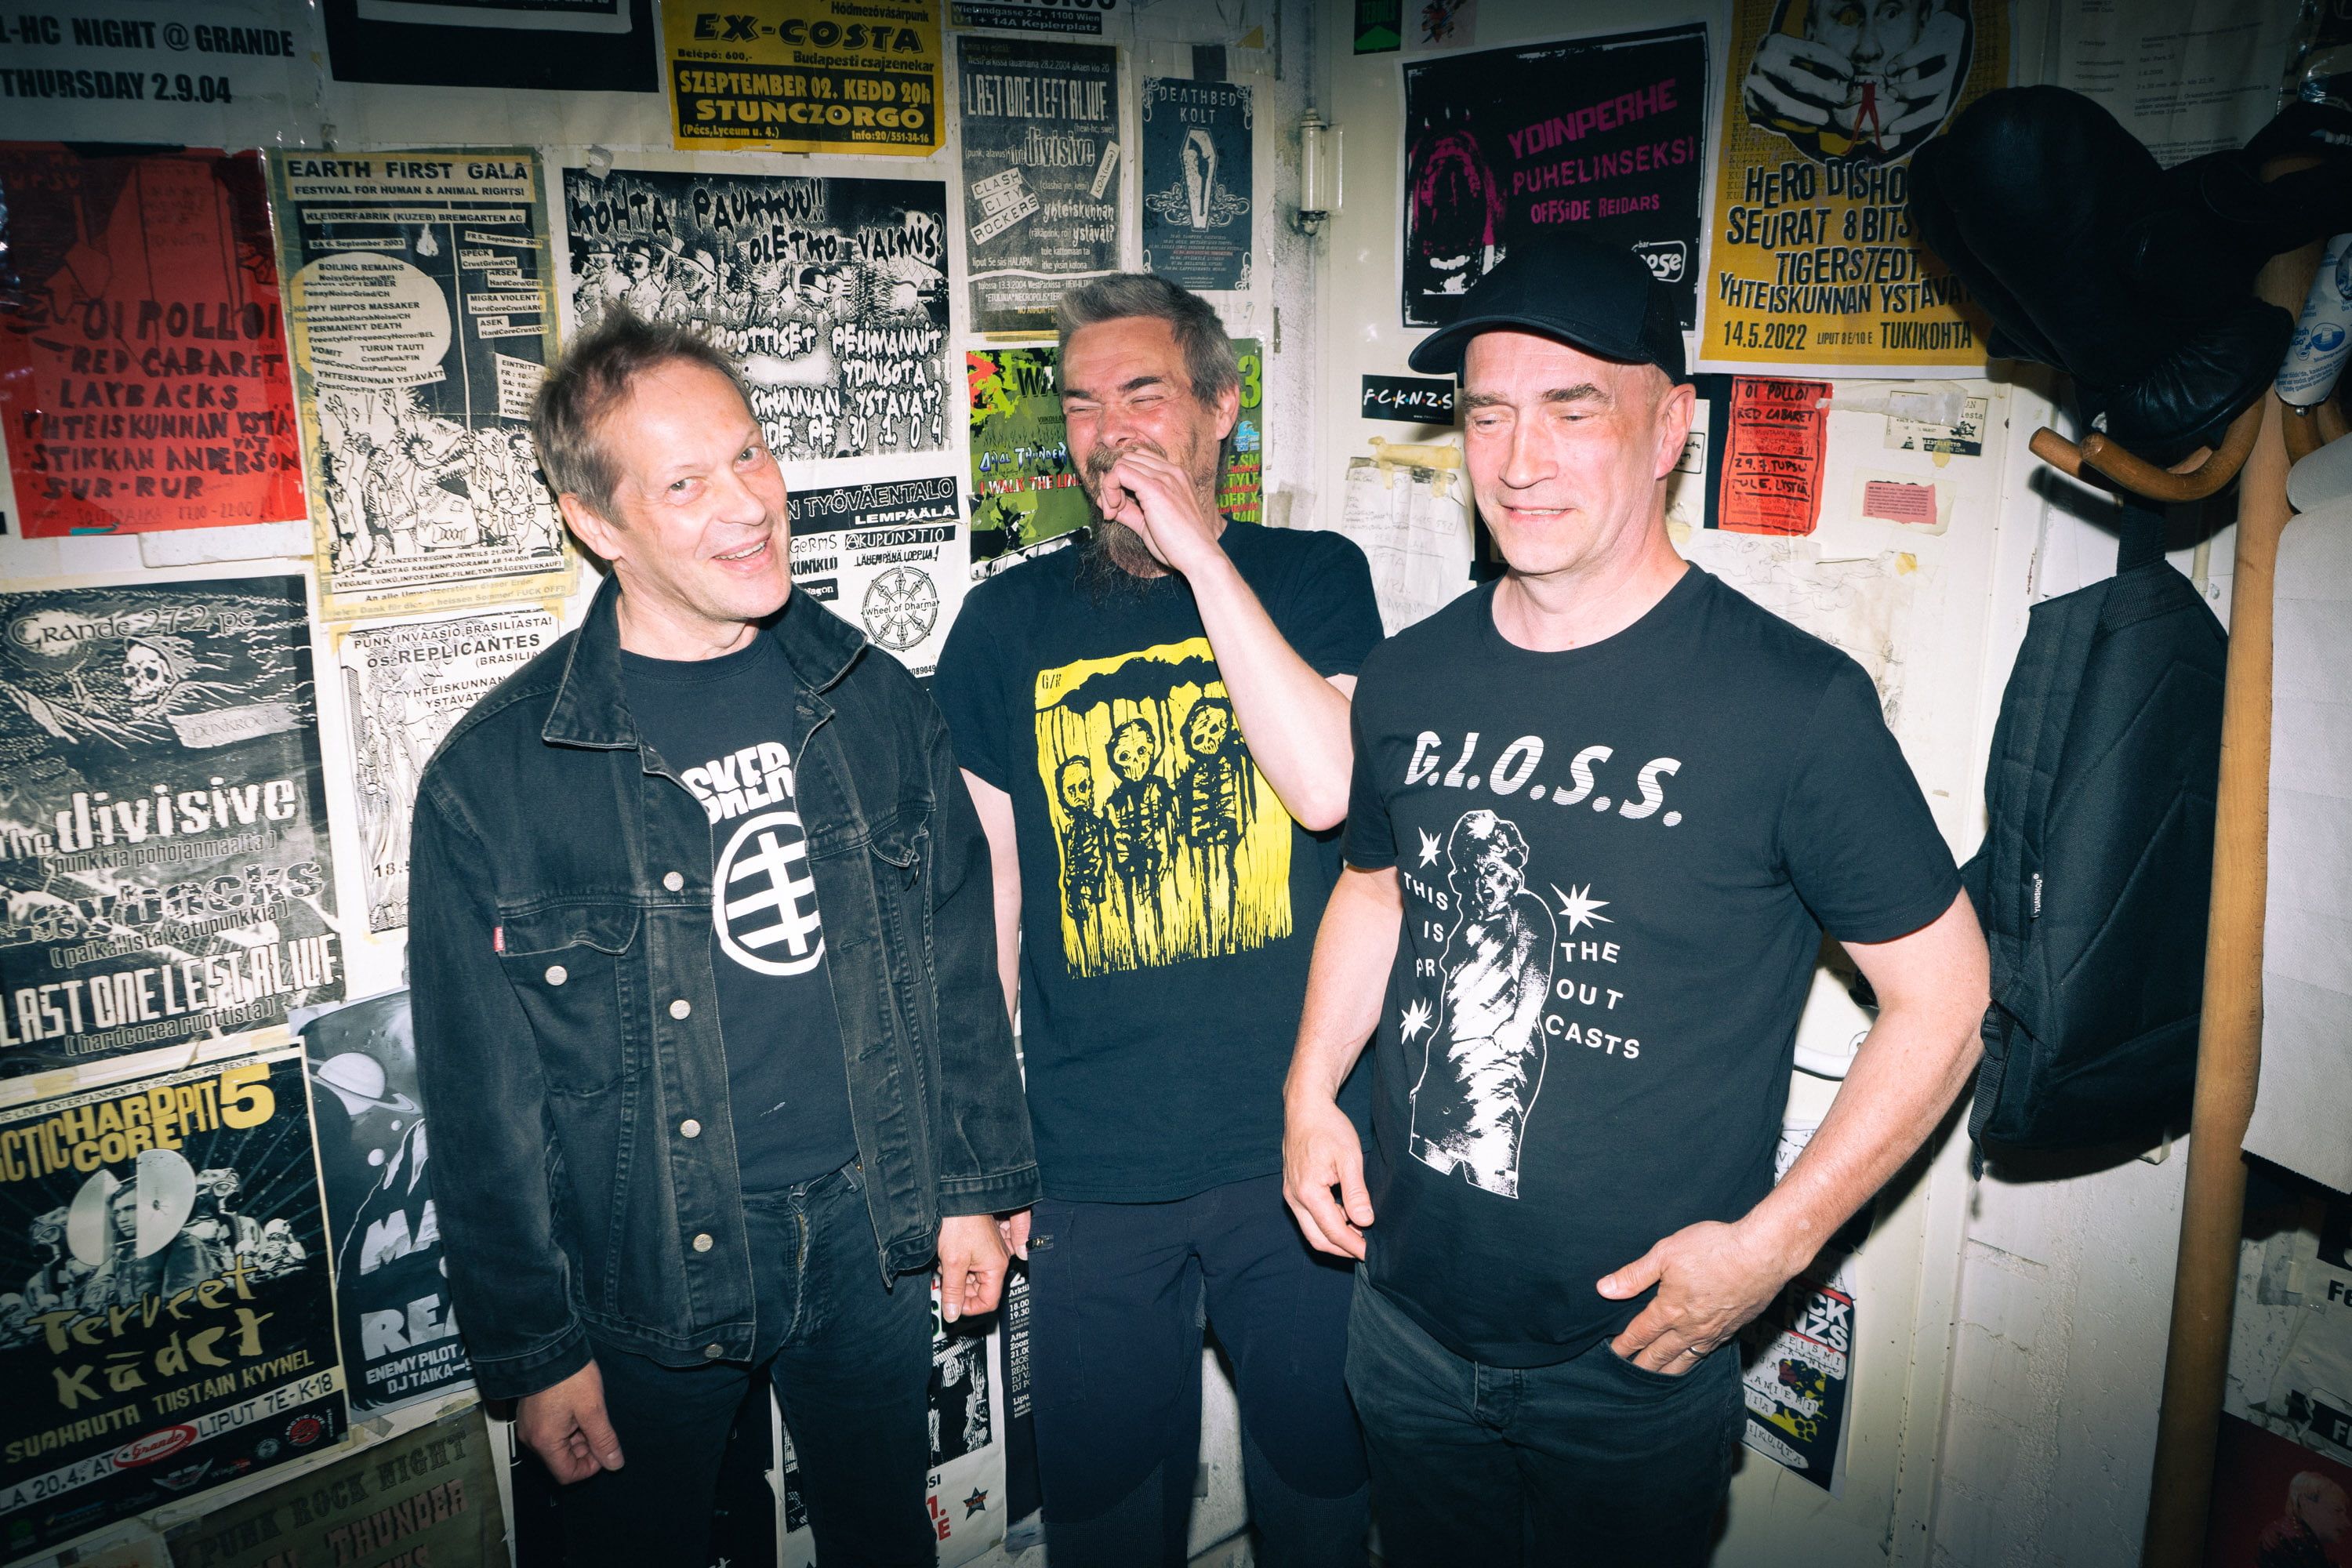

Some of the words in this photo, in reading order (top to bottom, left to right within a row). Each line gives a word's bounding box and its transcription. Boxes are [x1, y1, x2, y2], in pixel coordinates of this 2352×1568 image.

[693, 13, 924, 54] EX-COSTA
[1076, 13, 1100, 22] Wien
[71, 18, 156, 49] NIGHT
[163, 23, 191, 51] @
[194, 24, 296, 57] GRANDE
[793, 50, 858, 68] Budapesti
[860, 56, 934, 73] csajzenekar
[1, 68, 144, 100] THURSDAY
[151, 73, 232, 104] 2.9.04
[679, 71, 807, 98] SZEPTEMBER
[844, 79, 896, 102] KEDD
[901, 81, 931, 104] 20h
[967, 74, 1003, 117] LAST
[1004, 75, 1033, 118] ONE
[1034, 77, 1066, 119] LEFT
[1160, 85, 1237, 107] DEATHBED
[1180, 107, 1216, 123] KOLT
[1507, 78, 1678, 159] YDINPERHE
[288, 161, 371, 179] EARTH
[387, 162, 453, 179] FIRST
[468, 162, 528, 180] GALA
[1512, 135, 1695, 197] PUHELINSEKSI
[295, 186, 351, 195] FESTIVAL
[355, 186, 378, 195] FOR
[382, 186, 422, 195] HUMAN
[426, 187, 433, 195] &
[437, 187, 479, 196] ANIMAL
[974, 171, 1021, 196] CLASH
[985, 187, 1020, 212] CITY
[1744, 161, 1816, 209] HERO
[306, 212, 390, 222] KLEIDERFABRIK
[439, 213, 506, 223] BREMGARTEN
[509, 214, 523, 223] AG
[572, 182, 673, 237] KOHTA
[973, 197, 1039, 241] ROCKERS
[1530, 199, 1592, 225] OFFSIDE
[1598, 194, 1661, 219] REIDARS
[336, 239, 382, 249] September
[1726, 205, 1832, 250] SEURAT
[749, 224, 837, 266] OLETKO
[319, 263, 359, 271] BOILING
[361, 263, 405, 271] REMAINS
[1774, 246, 1922, 285] TIGERSTEDT
[368, 301, 420, 310] MASSAKER
[1719, 271, 1872, 314] YHTEISKUNNAN
[83, 298, 124, 341] OI
[136, 299, 278, 341] POLLOI
[307, 324, 367, 333] PERMANENT
[1724, 321, 1808, 350] 14.5.2022
[1817, 332, 1840, 345] LIPUT
[1879, 321, 1973, 350] TUKIKOHTA
[830, 319, 942, 359] PELIMANNIT
[71, 347, 129, 375] RED
[141, 347, 283, 377] CABARET
[840, 358, 926, 389] YDINSOTA
[60, 379, 238, 410] LAYBACKS
[22, 412, 230, 440] YHTEISKUNNAN
[1737, 407, 1762, 419] RED
[1766, 408, 1815, 423] CABARET
[30, 445, 155, 472] STIKKAN
[166, 445, 301, 475] ANDERSON
[804, 477, 954, 517] TYÖVÄENTALO
[988, 477, 1025, 495] WALK
[1029, 475, 1054, 491] THE
[855, 505, 956, 525] LEMPÄÄLÄ
[143, 604, 212, 636] 27.2
[217, 608, 257, 638] pe
[865, 604, 891, 616] Wheel
[894, 603, 902, 612] of
[904, 600, 937, 612] Dharma
[354, 633, 392, 650] PUNK
[465, 616, 553, 635] BRASILIASTA!
[398, 633, 541, 665] REPLICANTES
[1403, 730, 1683, 829] G.L.O.S.S.
[54, 776, 296, 855] divisive
[1403, 871, 1449, 912] THIS
[1424, 920, 1444, 942] IS
[1560, 940, 1621, 965] THE
[1555, 978, 1624, 1011] OUT
[1544, 1014, 1640, 1061] CASTS
[61, 1085, 180, 1146] HARD
[176, 1080, 220, 1137] PIT
[220, 1062, 275, 1131] 5
[72, 1112, 183, 1173] CORE
[365, 1354, 420, 1385] ENEMY
[418, 1343, 459, 1369] PILOT
[153, 1370, 238, 1416] TIISTAIN
[242, 1348, 315, 1388] KYYNEL
[387, 1375, 409, 1395] DJ
[93, 1451, 116, 1479] AT
[197, 1400, 257, 1438] LIPUT
[375, 1430, 469, 1492] NIGHT
[325, 1478, 469, 1561] THUNDER
